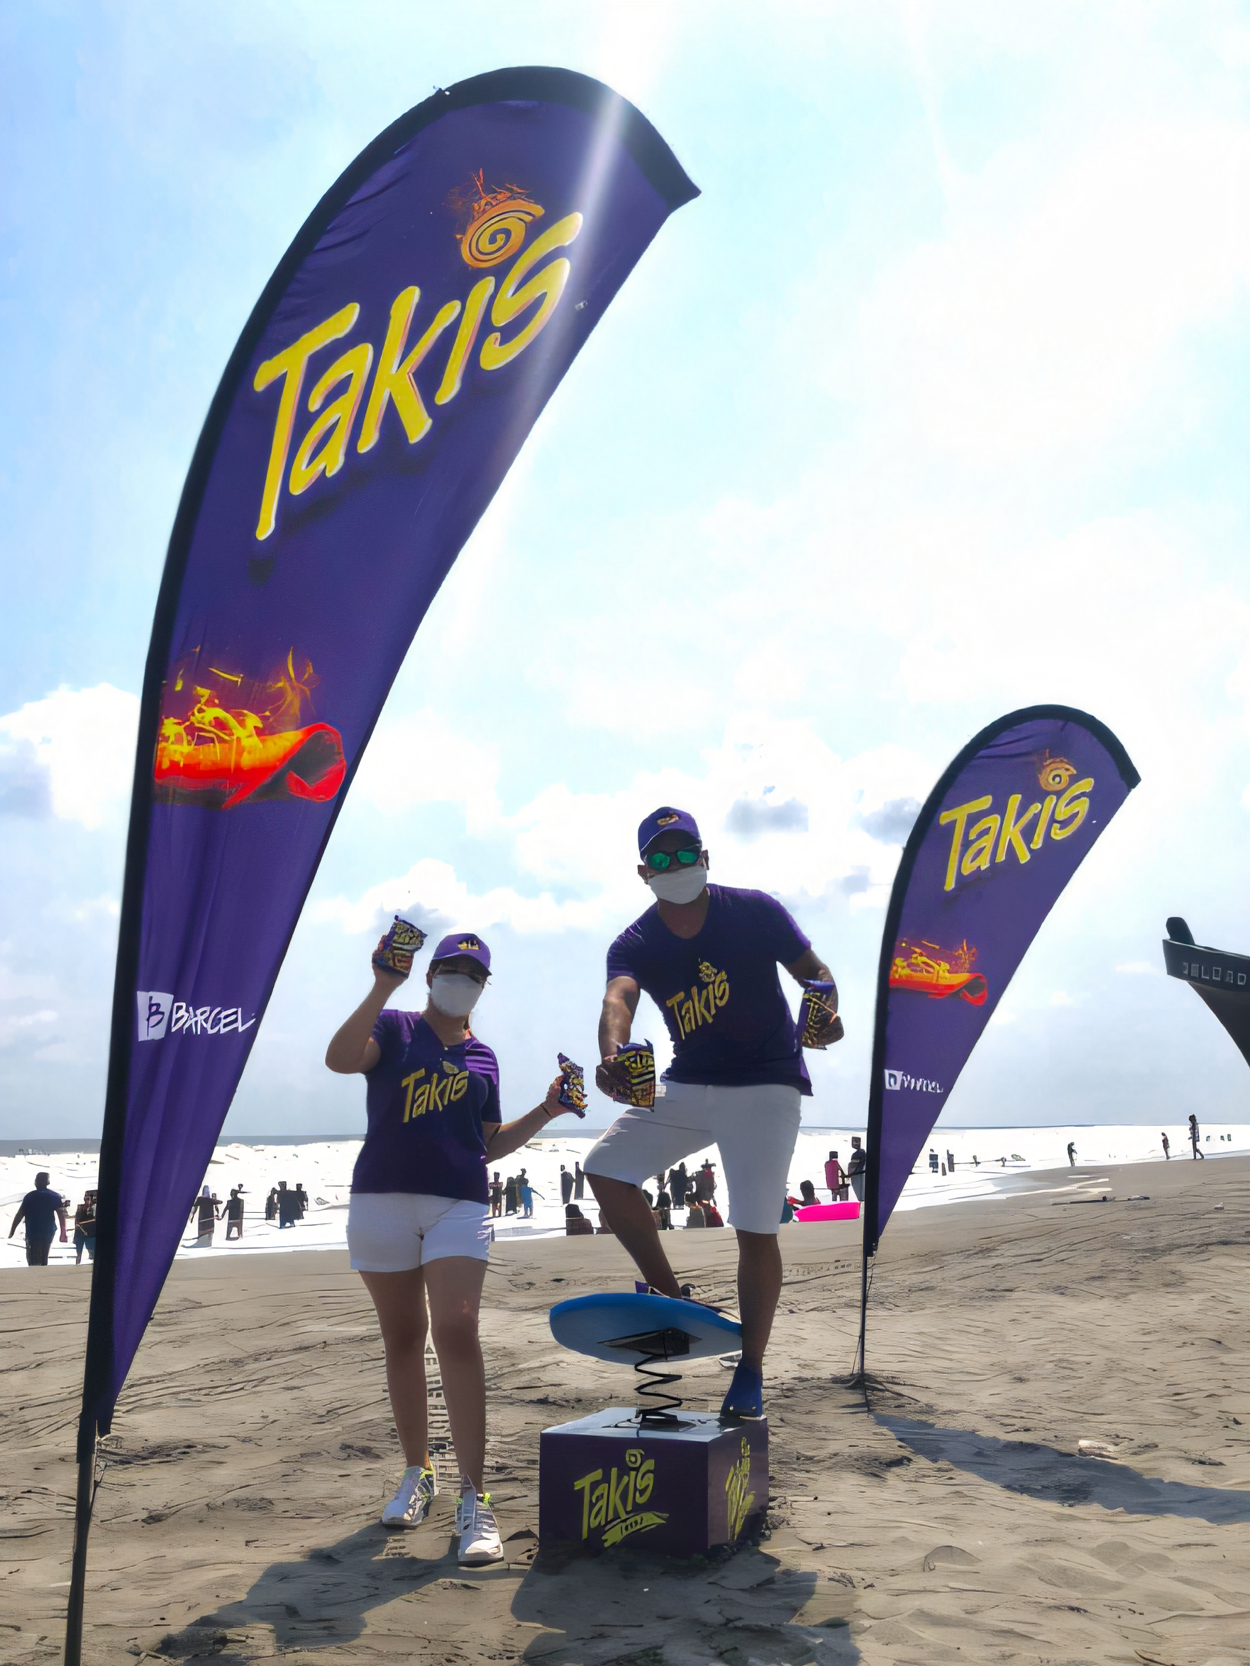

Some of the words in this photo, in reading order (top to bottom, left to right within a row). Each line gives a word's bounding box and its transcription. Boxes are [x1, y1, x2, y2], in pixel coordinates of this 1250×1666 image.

[253, 198, 584, 542] Takis
[939, 764, 1095, 892] Takis
[171, 1001, 256, 1035] BARCEL
[666, 962, 730, 1041] Takis
[573, 1449, 655, 1541] Takis
